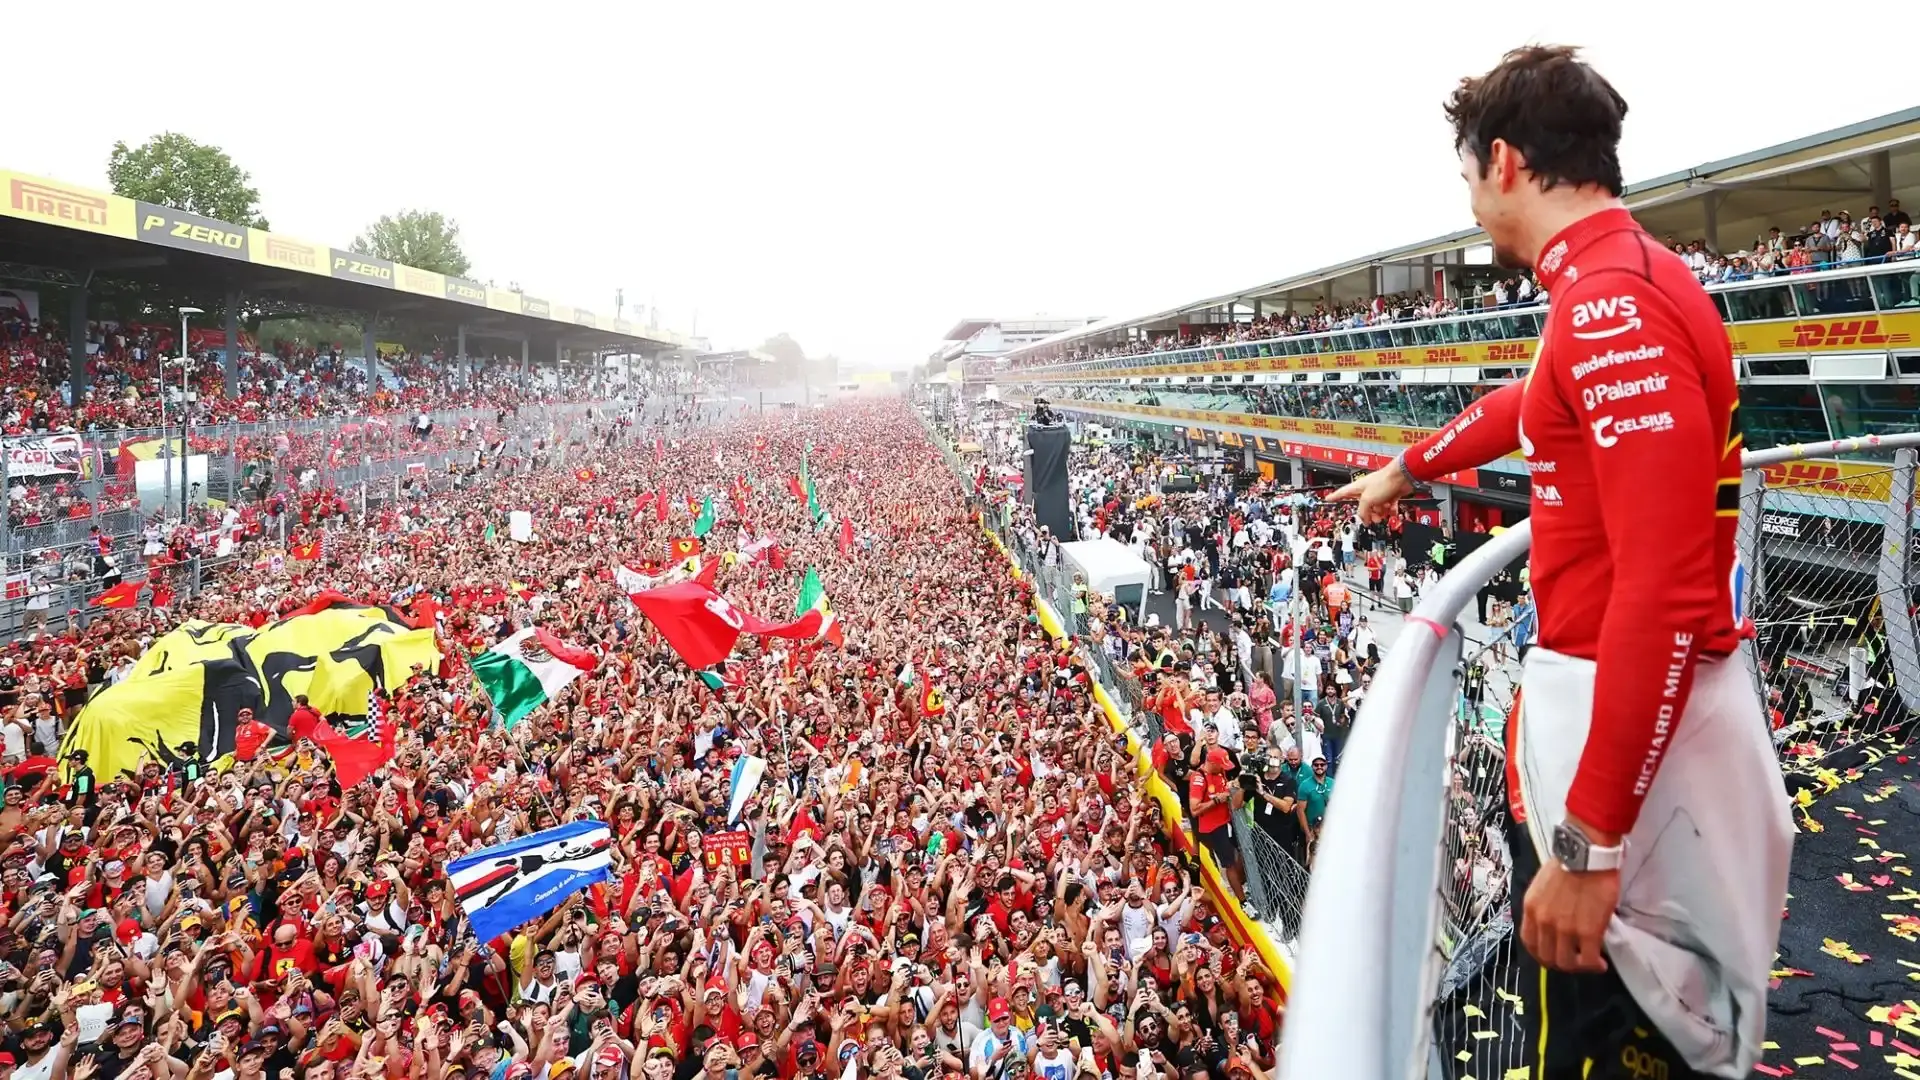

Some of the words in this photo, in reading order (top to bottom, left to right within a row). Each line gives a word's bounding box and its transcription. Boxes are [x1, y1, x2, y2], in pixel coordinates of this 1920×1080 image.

[11, 179, 107, 226] PIRELLI
[143, 215, 165, 231] P
[170, 221, 243, 249] ZERO
[335, 258, 346, 269] P
[349, 260, 391, 280] ZERO
[1572, 296, 1637, 327] aws
[1793, 320, 1889, 347] DHL
[1300, 357, 1320, 368] DHL
[1335, 355, 1359, 367] DHL
[1376, 352, 1405, 365] DHL
[1426, 348, 1460, 362] DHL
[1487, 343, 1529, 360] DHL
[1571, 344, 1664, 380] Bitdefender
[1594, 371, 1669, 404] Palantir
[1314, 423, 1336, 435] DHL
[1354, 426, 1381, 440] DHL
[1613, 411, 1674, 434] CELSIUS
[1423, 429, 1456, 463] RICHARD
[1455, 406, 1484, 434] MILLE
[1760, 463, 1848, 492] DHL
[1762, 514, 1799, 527] GEORGE
[1762, 523, 1800, 537] RUSSELL
[1633, 704, 1673, 796] RICHARD
[1663, 631, 1693, 698] MILLE
